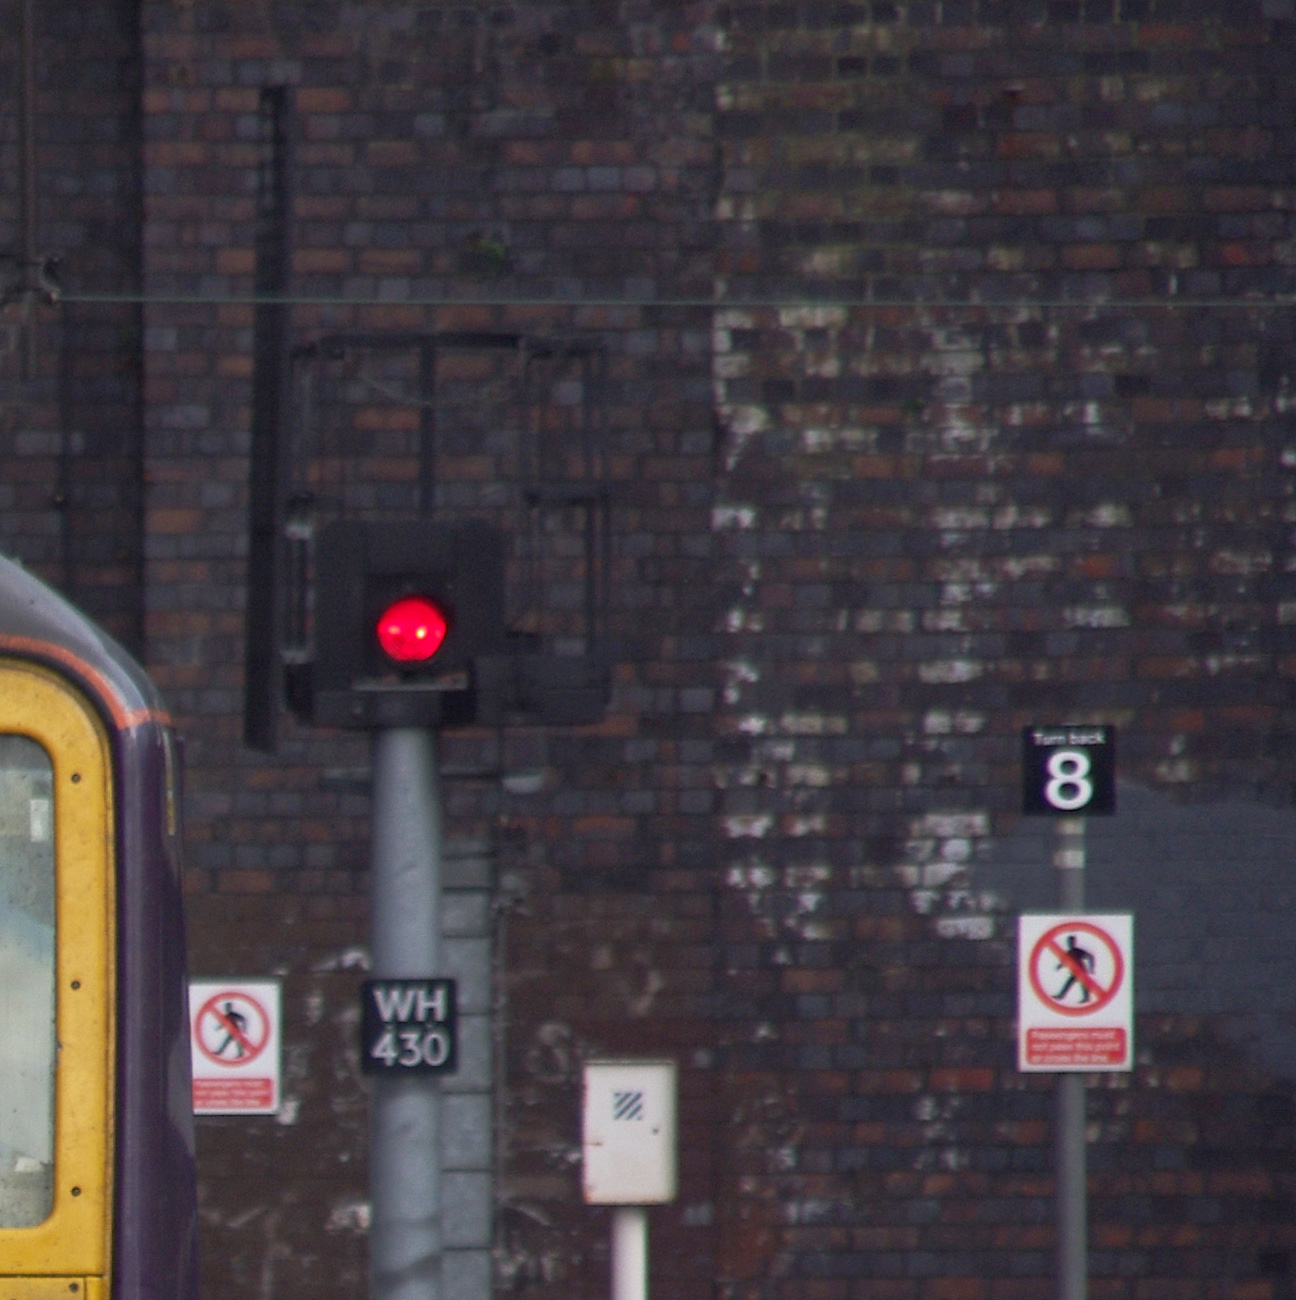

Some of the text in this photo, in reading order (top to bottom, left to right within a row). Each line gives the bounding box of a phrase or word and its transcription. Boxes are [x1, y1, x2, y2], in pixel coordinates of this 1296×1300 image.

[1044, 750, 1094, 810] 8
[372, 986, 448, 1023] WH
[371, 1031, 449, 1067] 430
